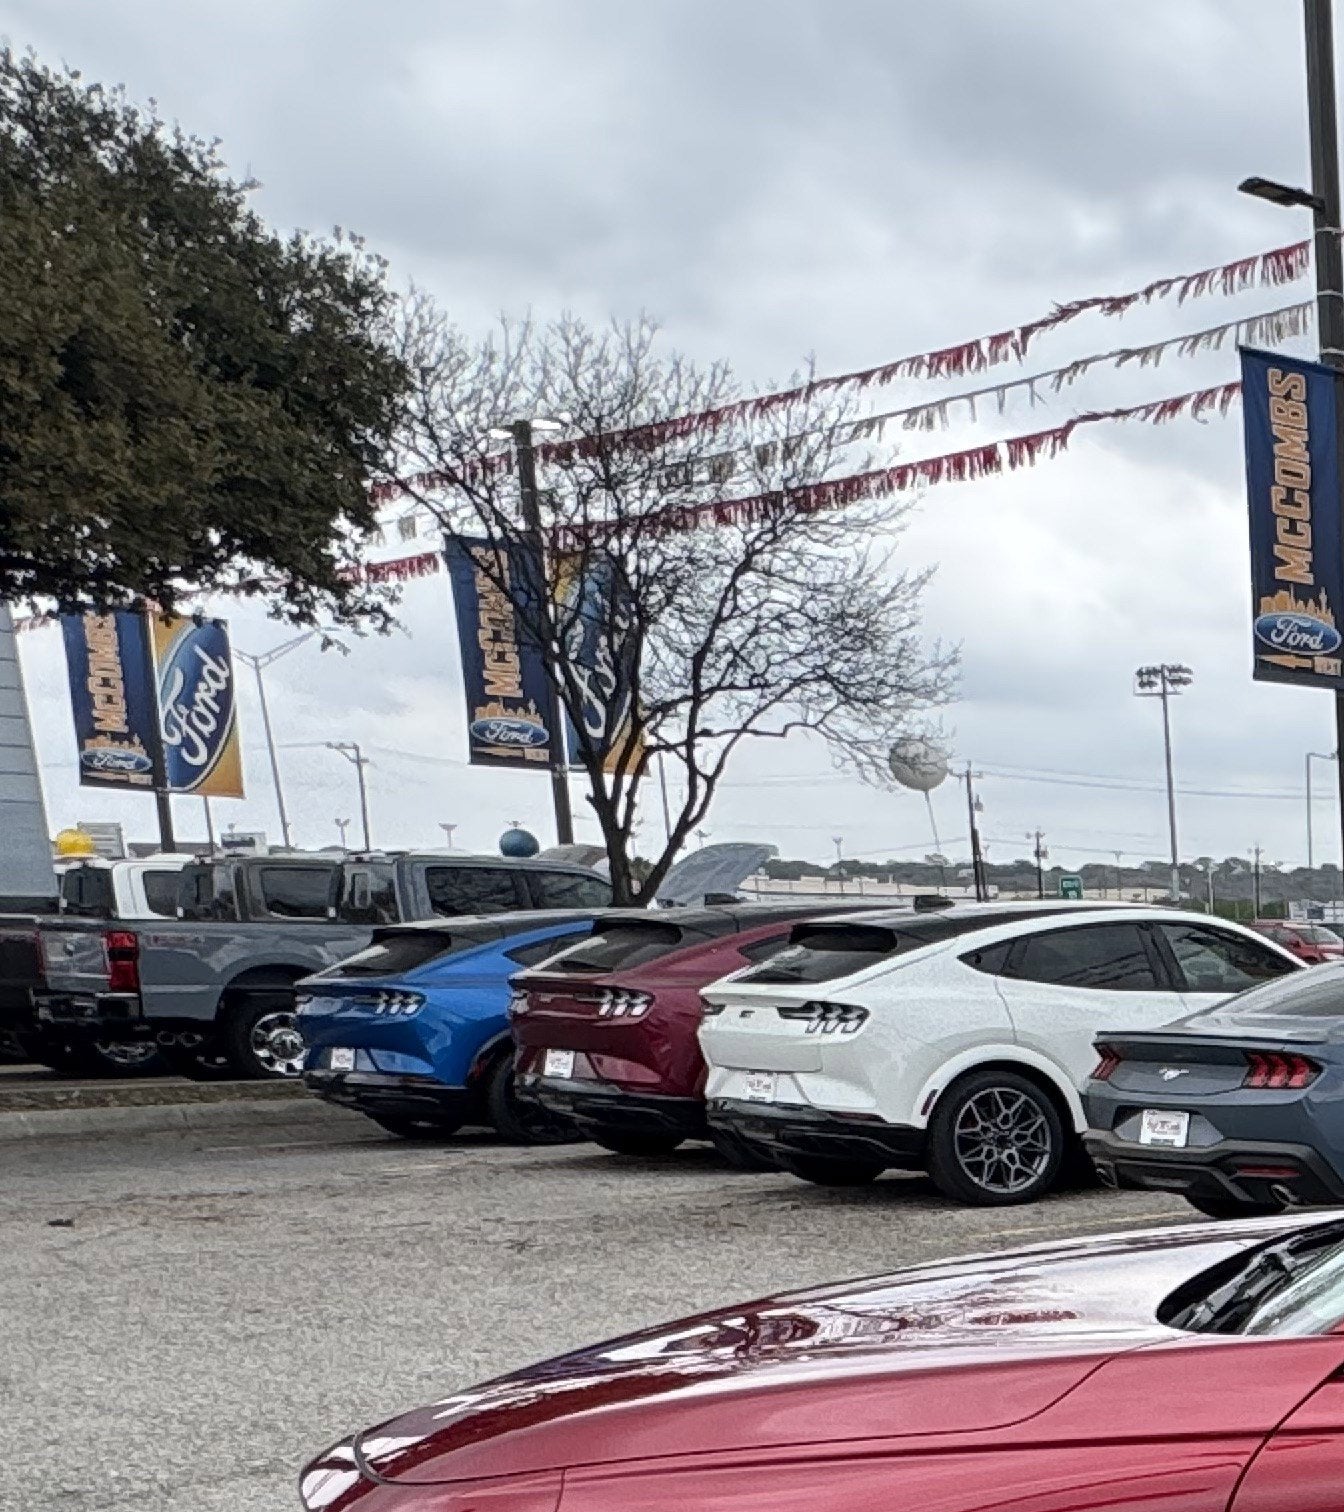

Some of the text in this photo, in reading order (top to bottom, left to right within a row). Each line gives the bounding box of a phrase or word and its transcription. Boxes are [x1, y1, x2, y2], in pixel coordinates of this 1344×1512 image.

[1267, 368, 1314, 586] MCCOMBS
[1270, 617, 1325, 650] Ford
[161, 644, 230, 766] Ford
[485, 720, 534, 743] Ford
